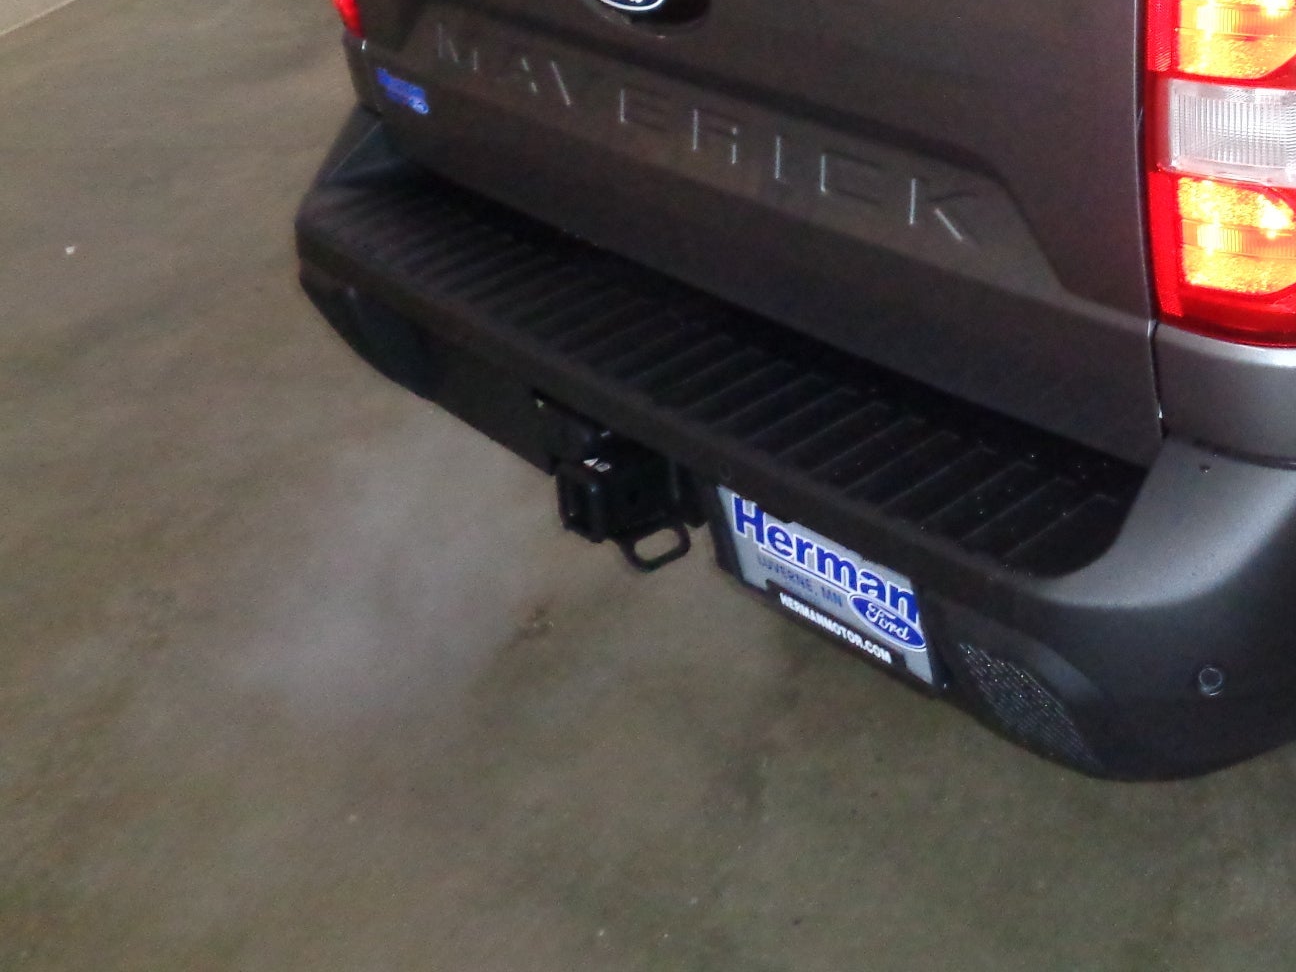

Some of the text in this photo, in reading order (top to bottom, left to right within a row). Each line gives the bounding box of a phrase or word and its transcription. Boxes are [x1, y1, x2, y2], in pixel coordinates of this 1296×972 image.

[437, 22, 980, 247] MAVERICK
[732, 494, 919, 625] Herman
[779, 592, 892, 664] HERMANMOTOR.COM
[865, 603, 911, 642] Ford
